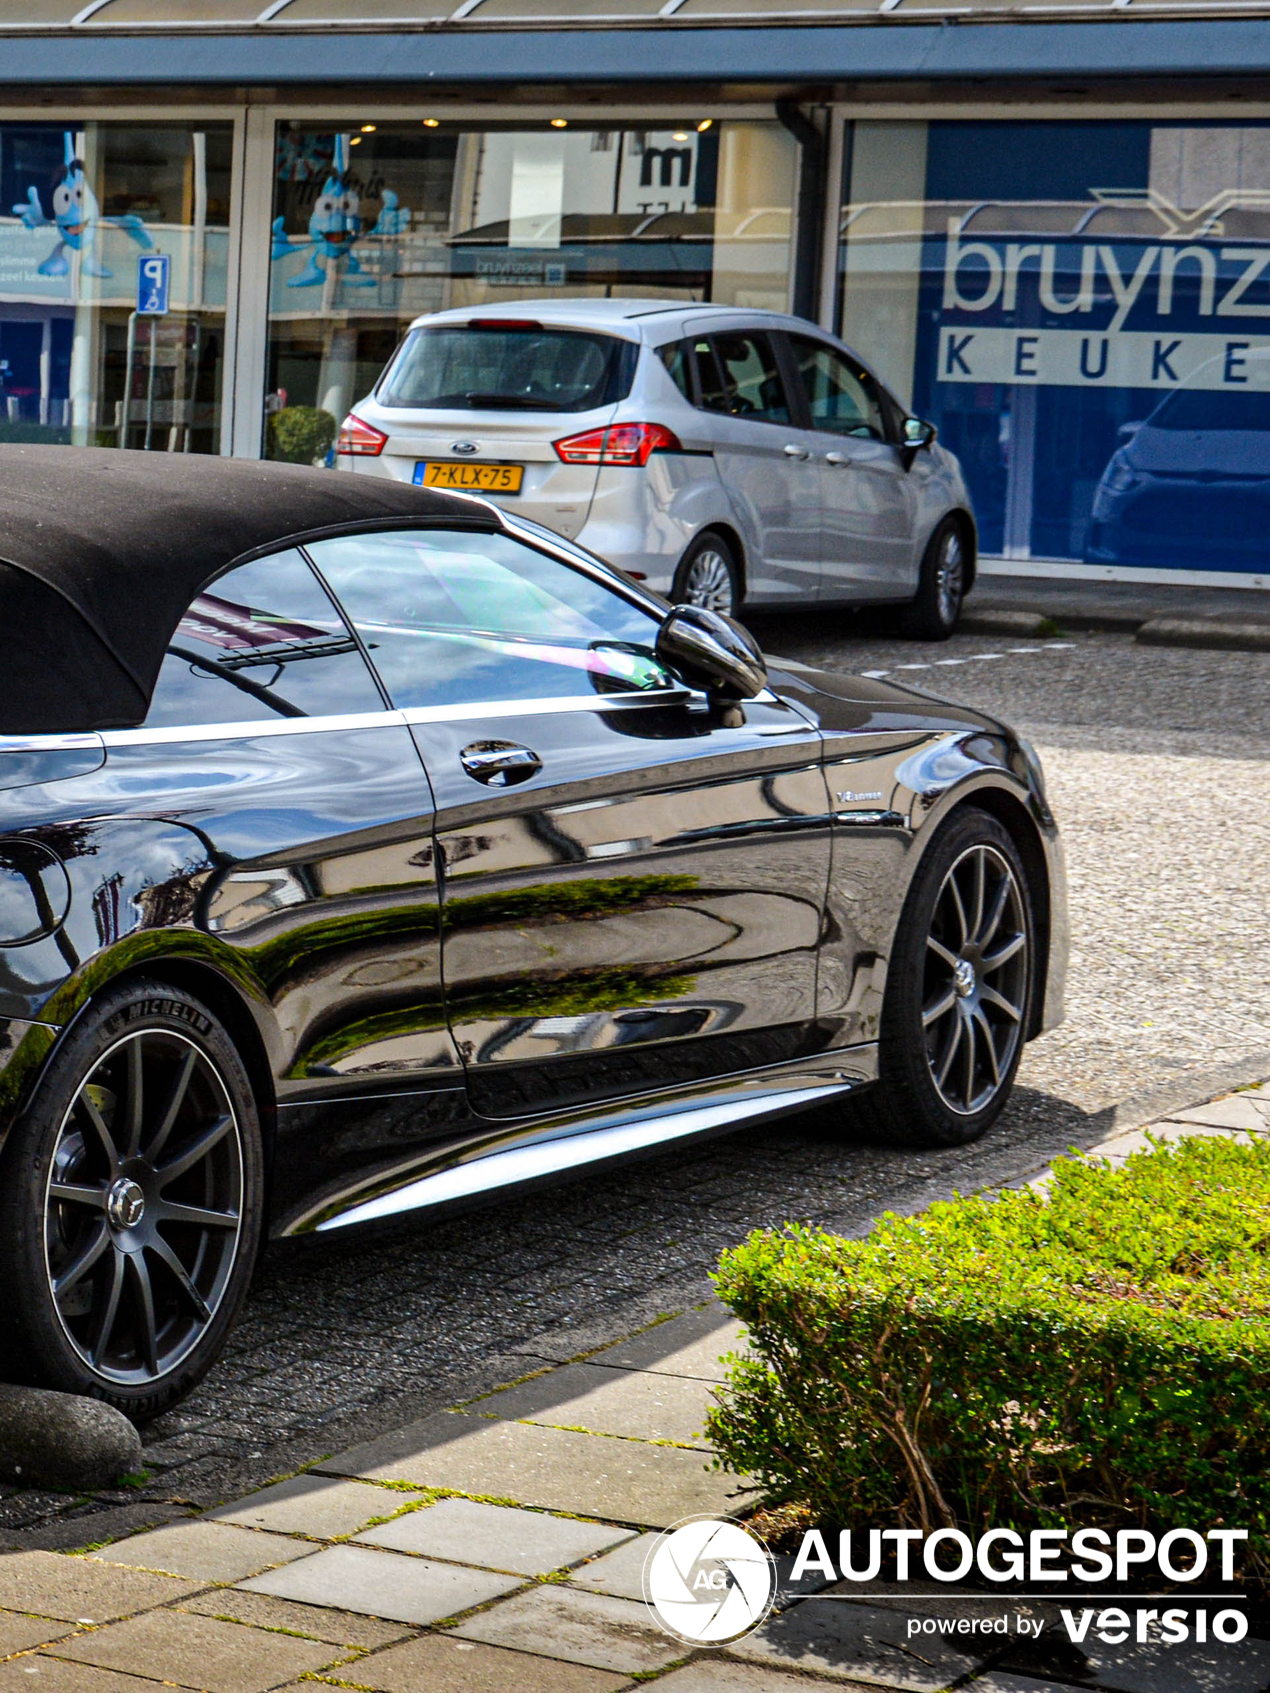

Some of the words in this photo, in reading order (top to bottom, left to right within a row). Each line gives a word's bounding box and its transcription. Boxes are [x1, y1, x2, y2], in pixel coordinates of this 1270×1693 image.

[942, 216, 1270, 332] bruynz
[945, 334, 1249, 383] KEUKE
[430, 466, 512, 487] 7-KLX-75
[129, 1000, 212, 1032] MICHELIN
